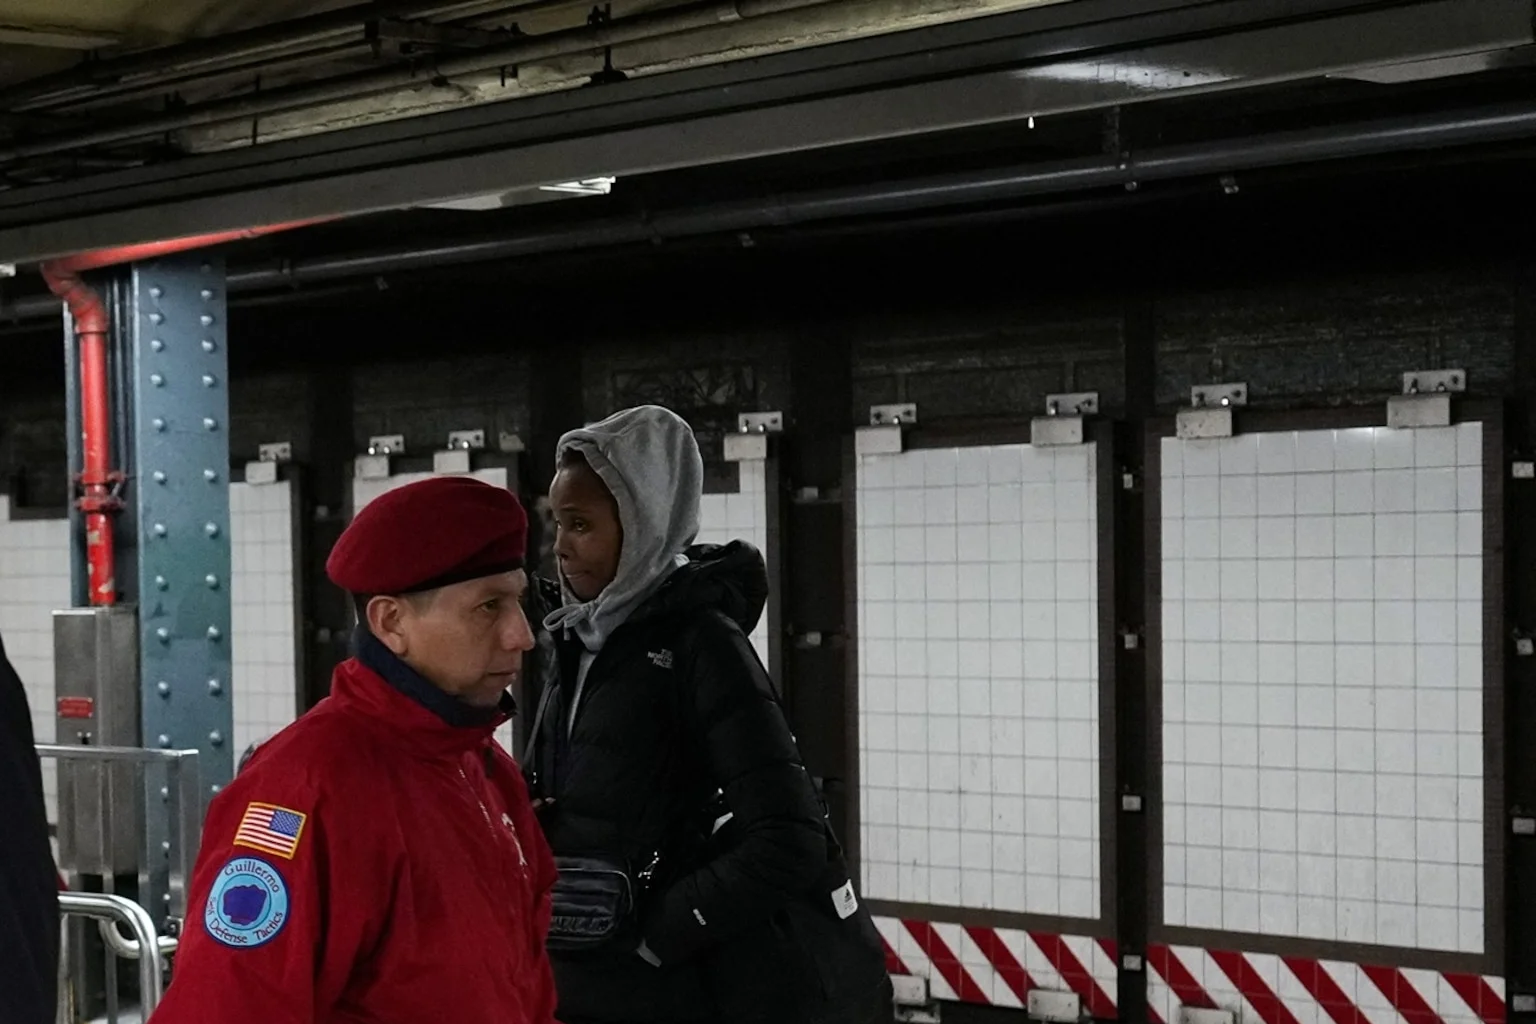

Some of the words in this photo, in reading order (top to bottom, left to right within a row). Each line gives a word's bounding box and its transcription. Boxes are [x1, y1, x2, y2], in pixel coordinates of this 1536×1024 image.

[224, 861, 280, 893] Guillermo
[209, 918, 248, 944] Defense
[253, 911, 283, 941] Tactics
